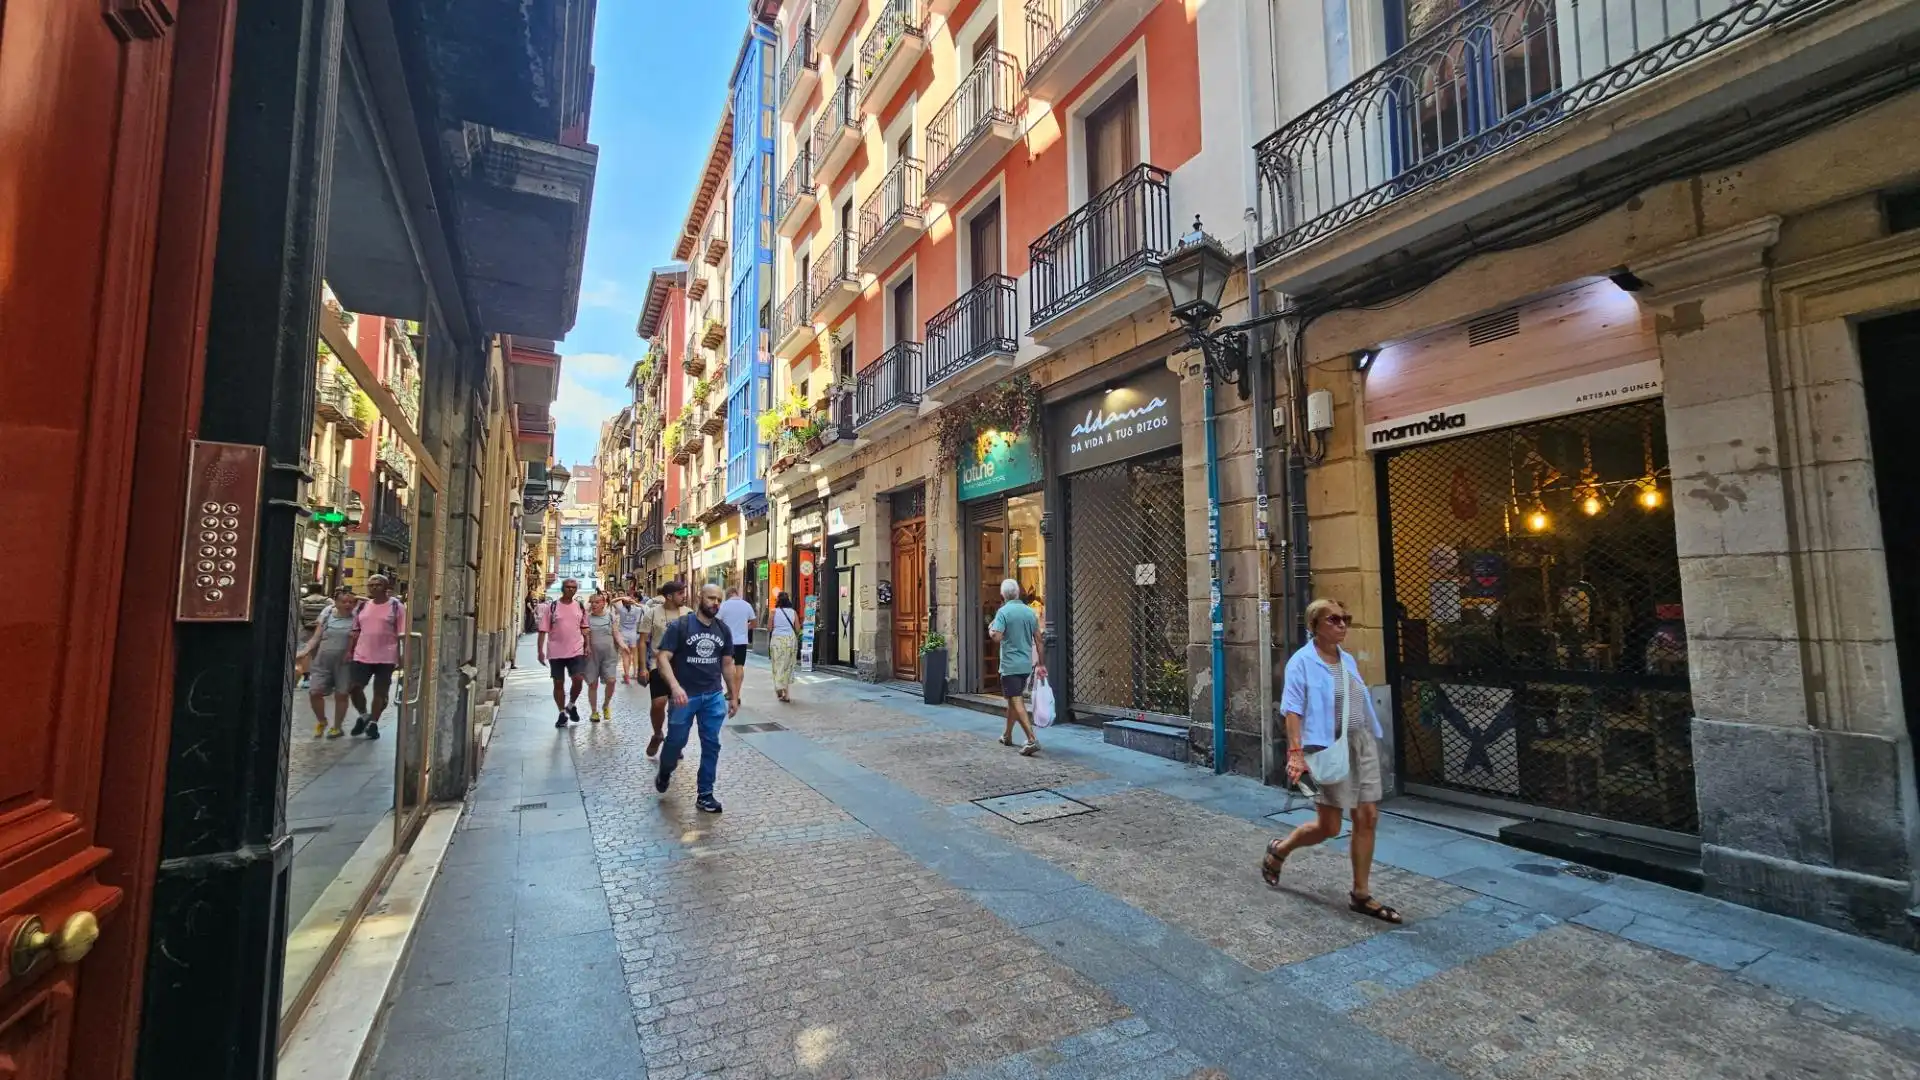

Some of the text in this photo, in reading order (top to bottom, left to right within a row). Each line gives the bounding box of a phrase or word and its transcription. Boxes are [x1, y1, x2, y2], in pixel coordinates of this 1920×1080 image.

[1576, 381, 1658, 402] ARTISAU GUNEA
[1071, 415, 1169, 454] DA VIDA A TUS RIZOS
[1372, 412, 1466, 444] marmöka
[686, 632, 724, 646] COLORADO
[686, 656, 719, 664] UNIVERSIT
